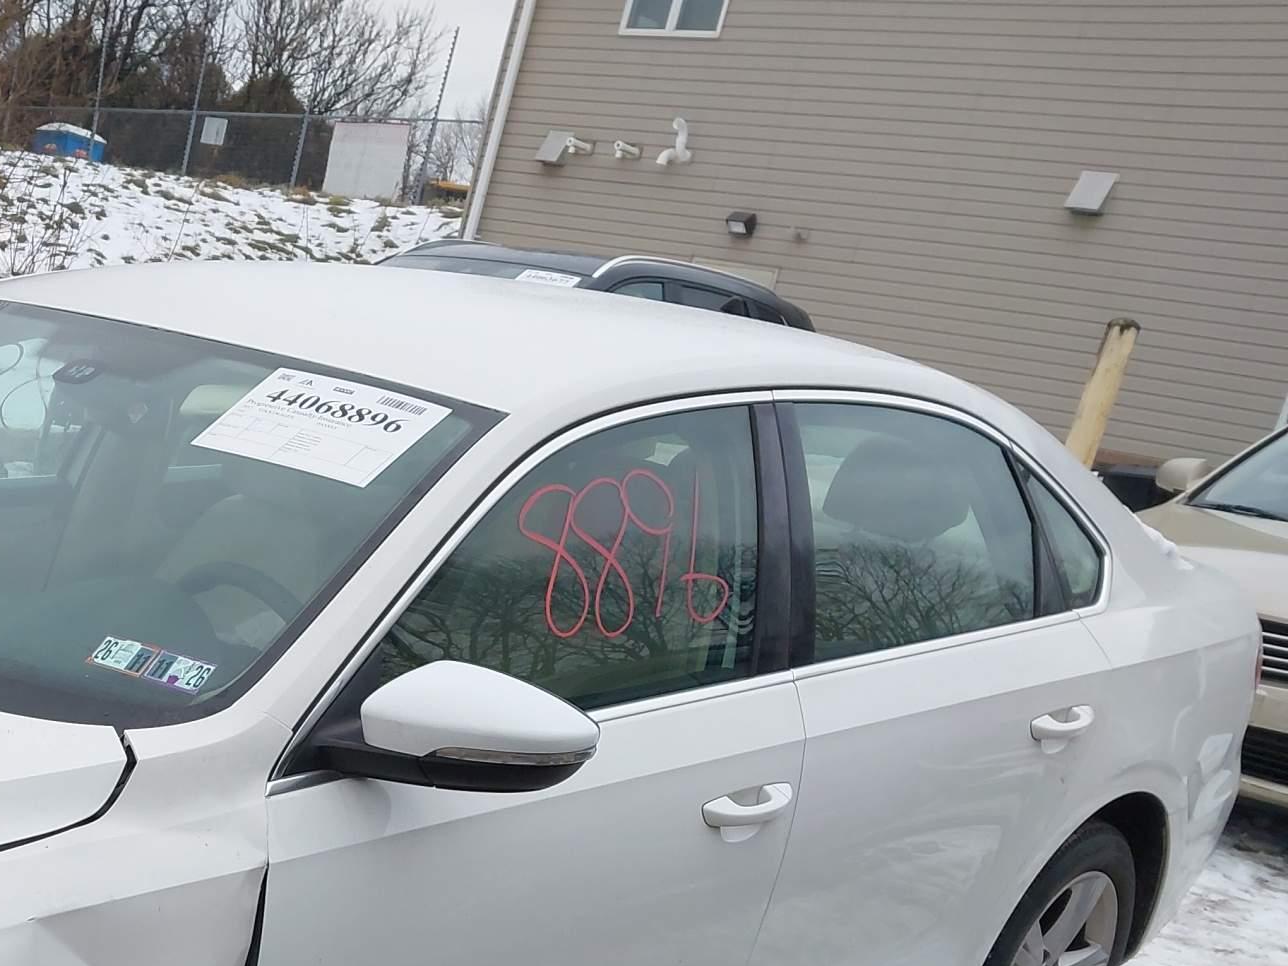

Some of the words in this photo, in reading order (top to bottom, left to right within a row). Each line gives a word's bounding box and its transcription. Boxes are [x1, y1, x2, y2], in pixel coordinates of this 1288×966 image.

[267, 389, 409, 433] 44068896
[518, 469, 730, 638] 8896
[94, 639, 119, 660] 26
[185, 665, 211, 688] 26
